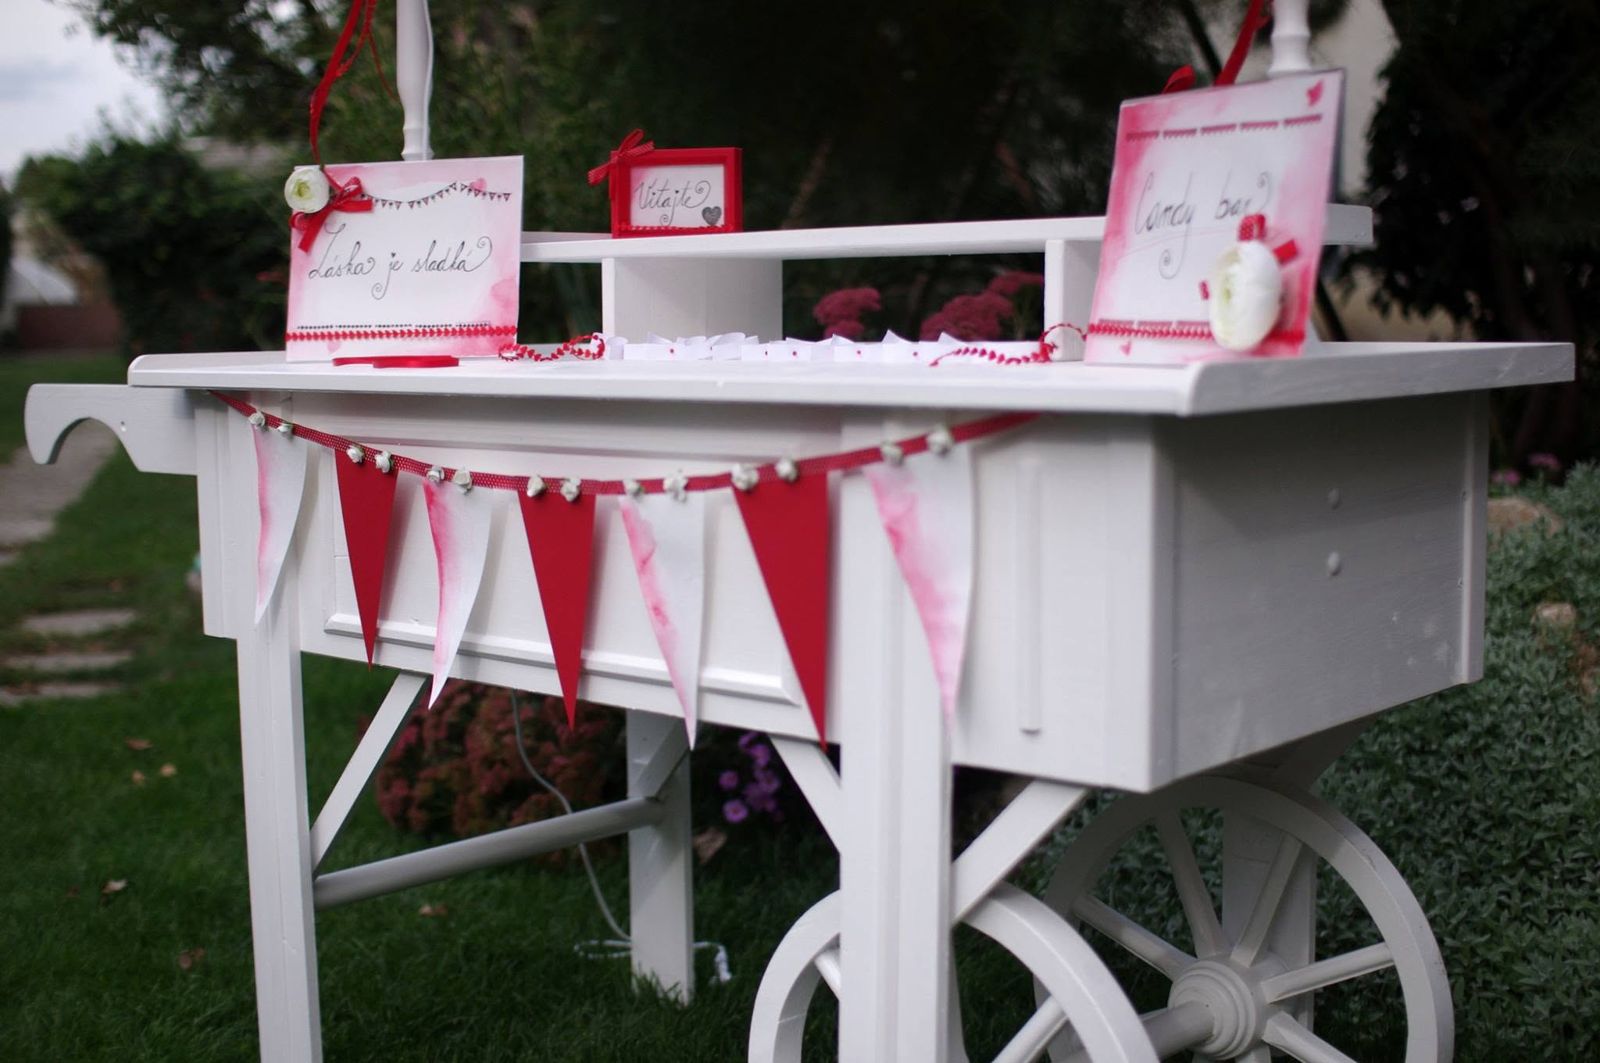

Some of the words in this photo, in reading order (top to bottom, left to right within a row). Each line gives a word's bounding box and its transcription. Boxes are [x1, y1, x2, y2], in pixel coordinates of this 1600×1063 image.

[634, 178, 711, 227] Vitajte
[1135, 171, 1195, 279] Candy
[1214, 170, 1272, 220] bar
[309, 223, 376, 279] Láska
[371, 252, 403, 300] je
[411, 236, 493, 272] sladká
